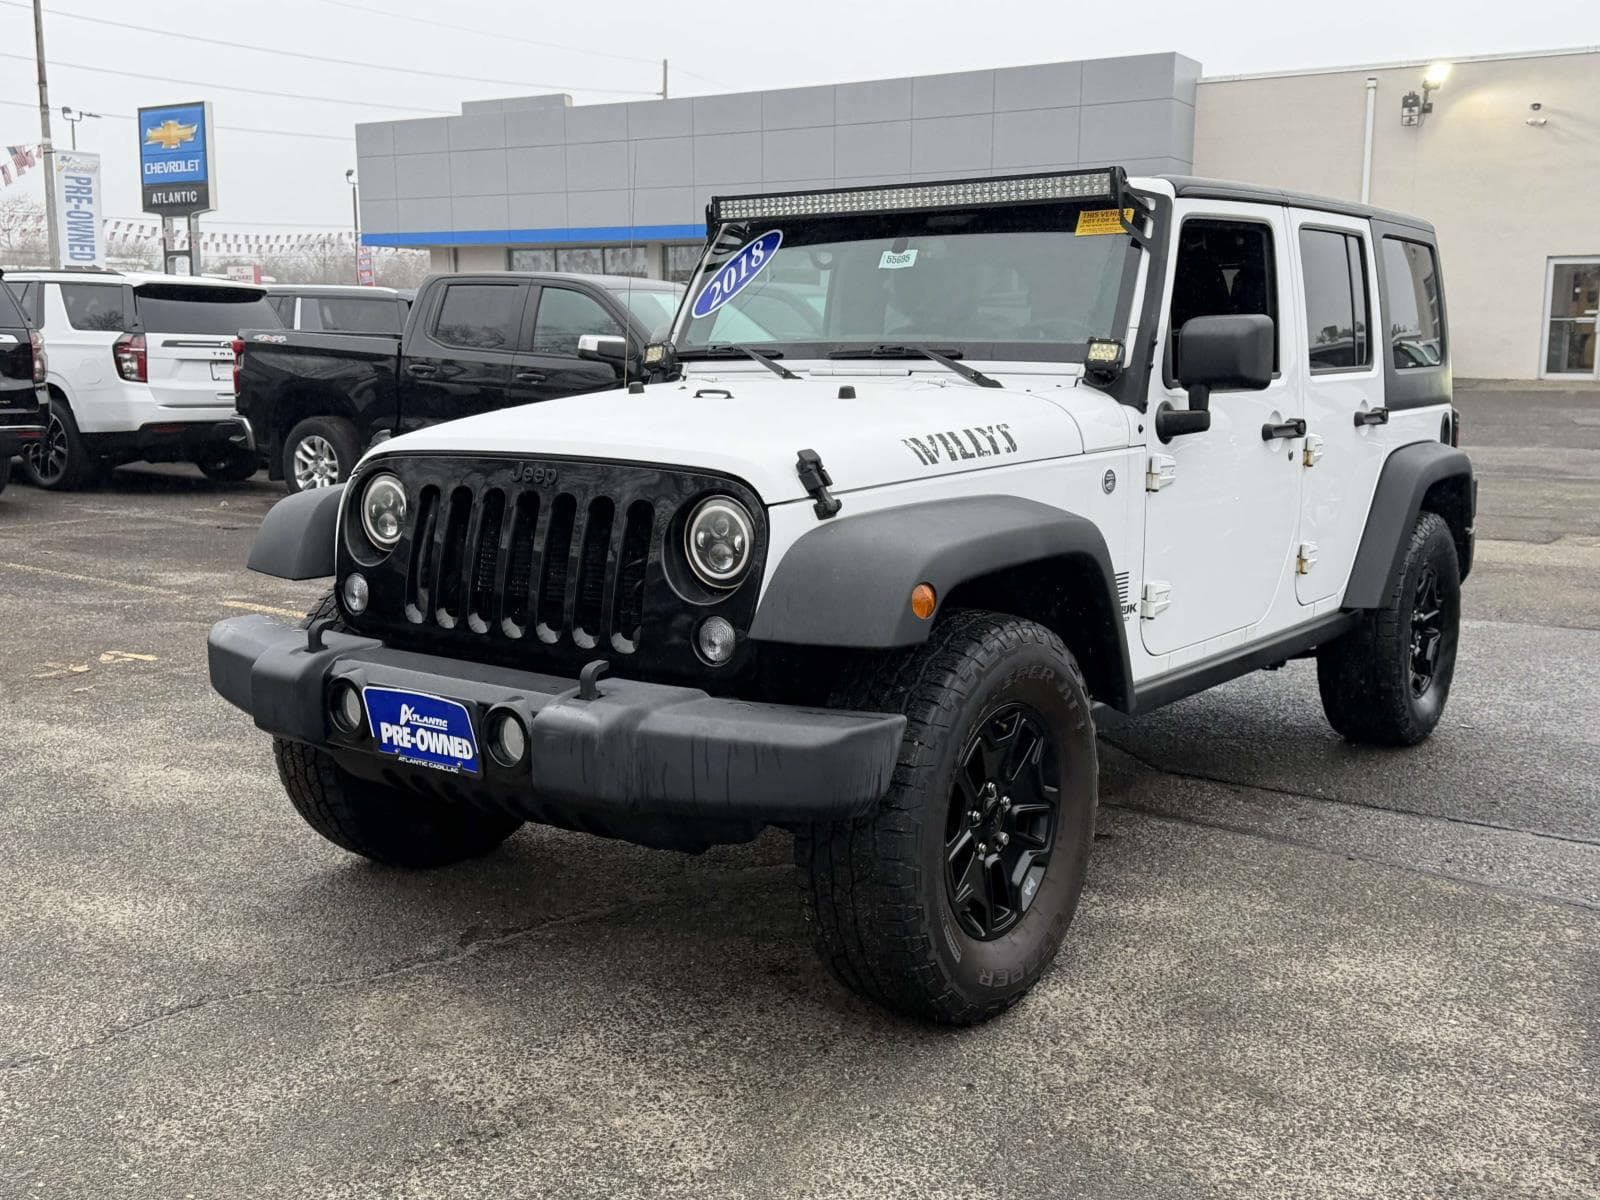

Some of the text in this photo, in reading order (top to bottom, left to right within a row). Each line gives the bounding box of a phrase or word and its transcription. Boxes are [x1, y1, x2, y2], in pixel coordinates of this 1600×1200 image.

[145, 160, 200, 174] CHEVROLET
[152, 191, 197, 204] ATLANTIC
[64, 175, 96, 261] PRE-OWNED
[709, 240, 764, 310] 2018
[901, 423, 1017, 465] WILLYS
[510, 461, 558, 489] Jeep
[400, 703, 448, 727] ATLANTIC
[380, 722, 474, 760] PRE-OWNED
[398, 756, 428, 767] ATLANTIC
[428, 762, 460, 774] CADILLAC
